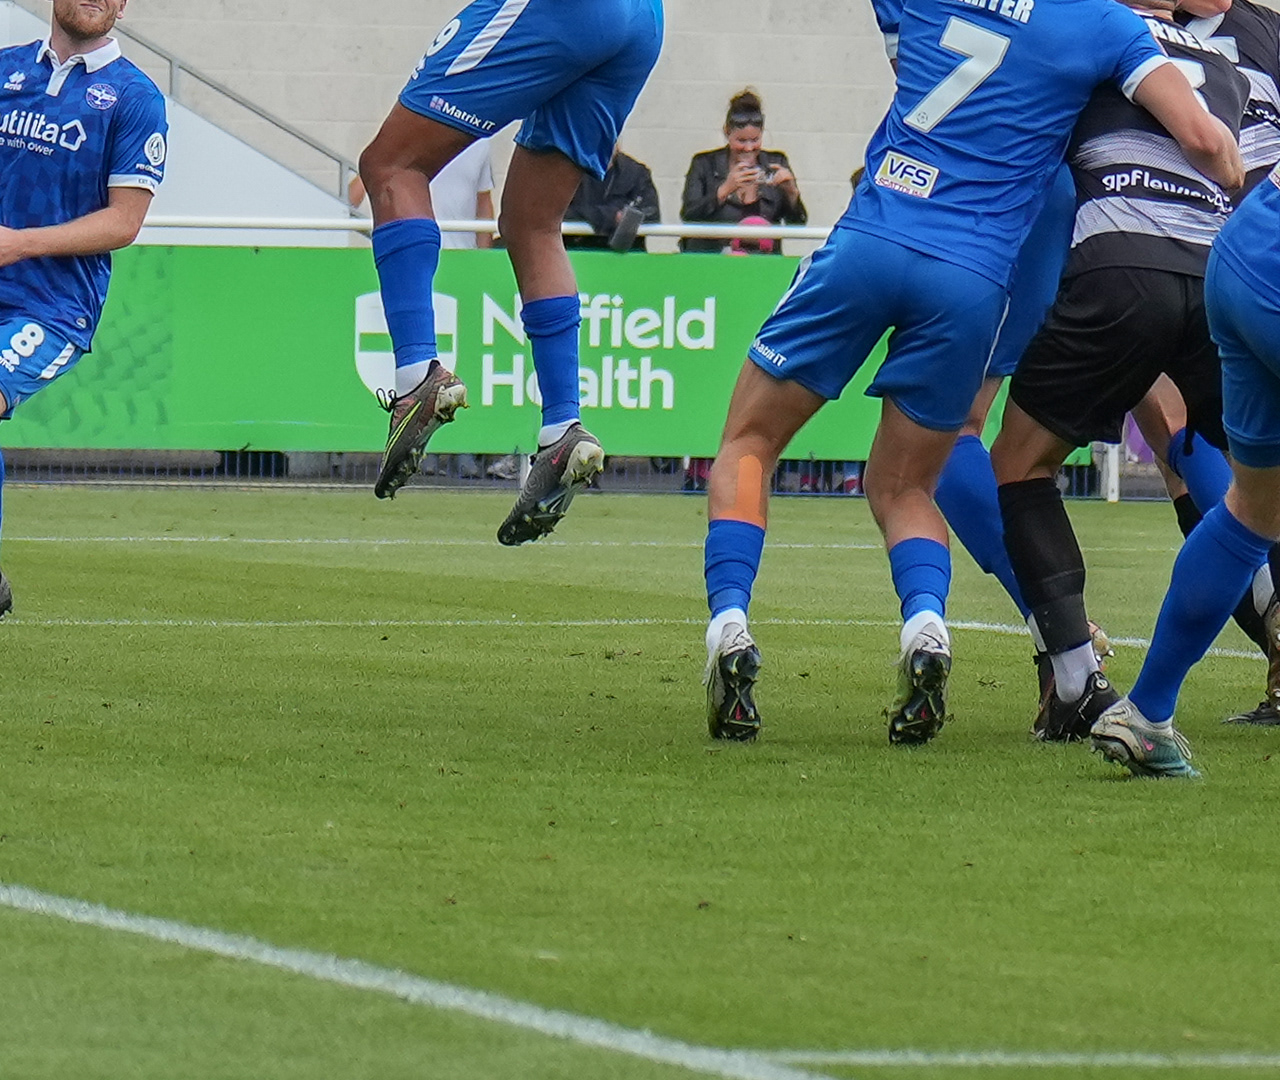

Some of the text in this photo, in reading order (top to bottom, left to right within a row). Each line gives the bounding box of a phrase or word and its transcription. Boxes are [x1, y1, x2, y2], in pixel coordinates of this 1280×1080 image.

[426, 18, 461, 58] 9
[903, 16, 1012, 134] 7
[442, 101, 496, 131] Matrix IT
[888, 156, 932, 190] VFS
[9, 322, 46, 358] 8
[482, 293, 716, 350] Nffield
